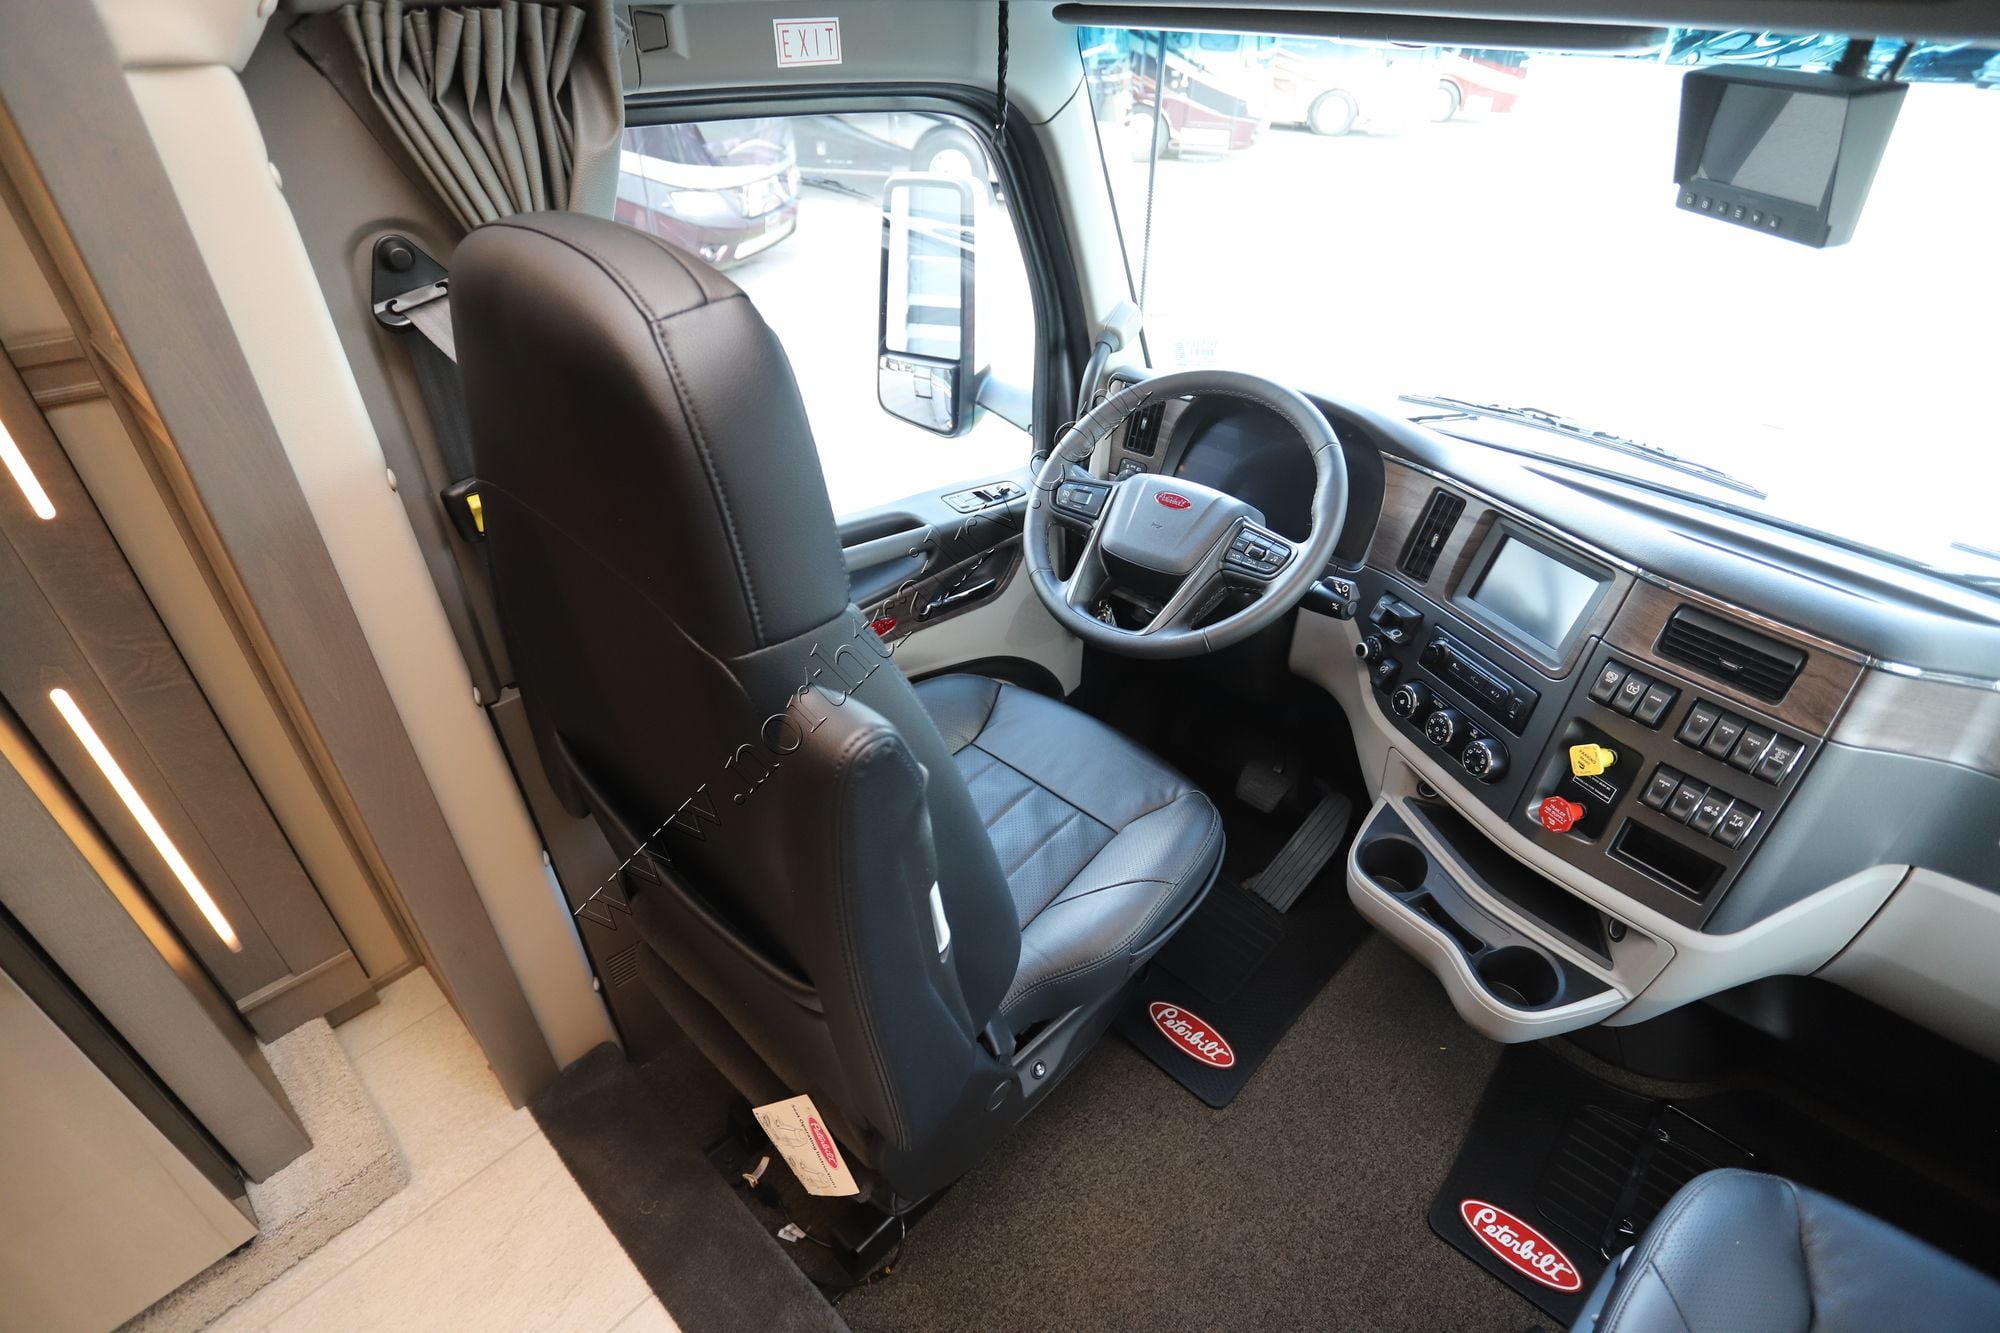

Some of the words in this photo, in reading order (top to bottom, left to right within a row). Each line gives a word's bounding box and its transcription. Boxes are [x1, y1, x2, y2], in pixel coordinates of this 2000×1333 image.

[781, 27, 833, 58] EXIT
[1696, 714, 1710, 722] SPARE
[1549, 804, 1566, 817] TRAILER
[1551, 809, 1567, 823] SUPPLY
[1157, 1008, 1229, 1061] Peterbilt
[1473, 1208, 1573, 1281] Peterbilt
